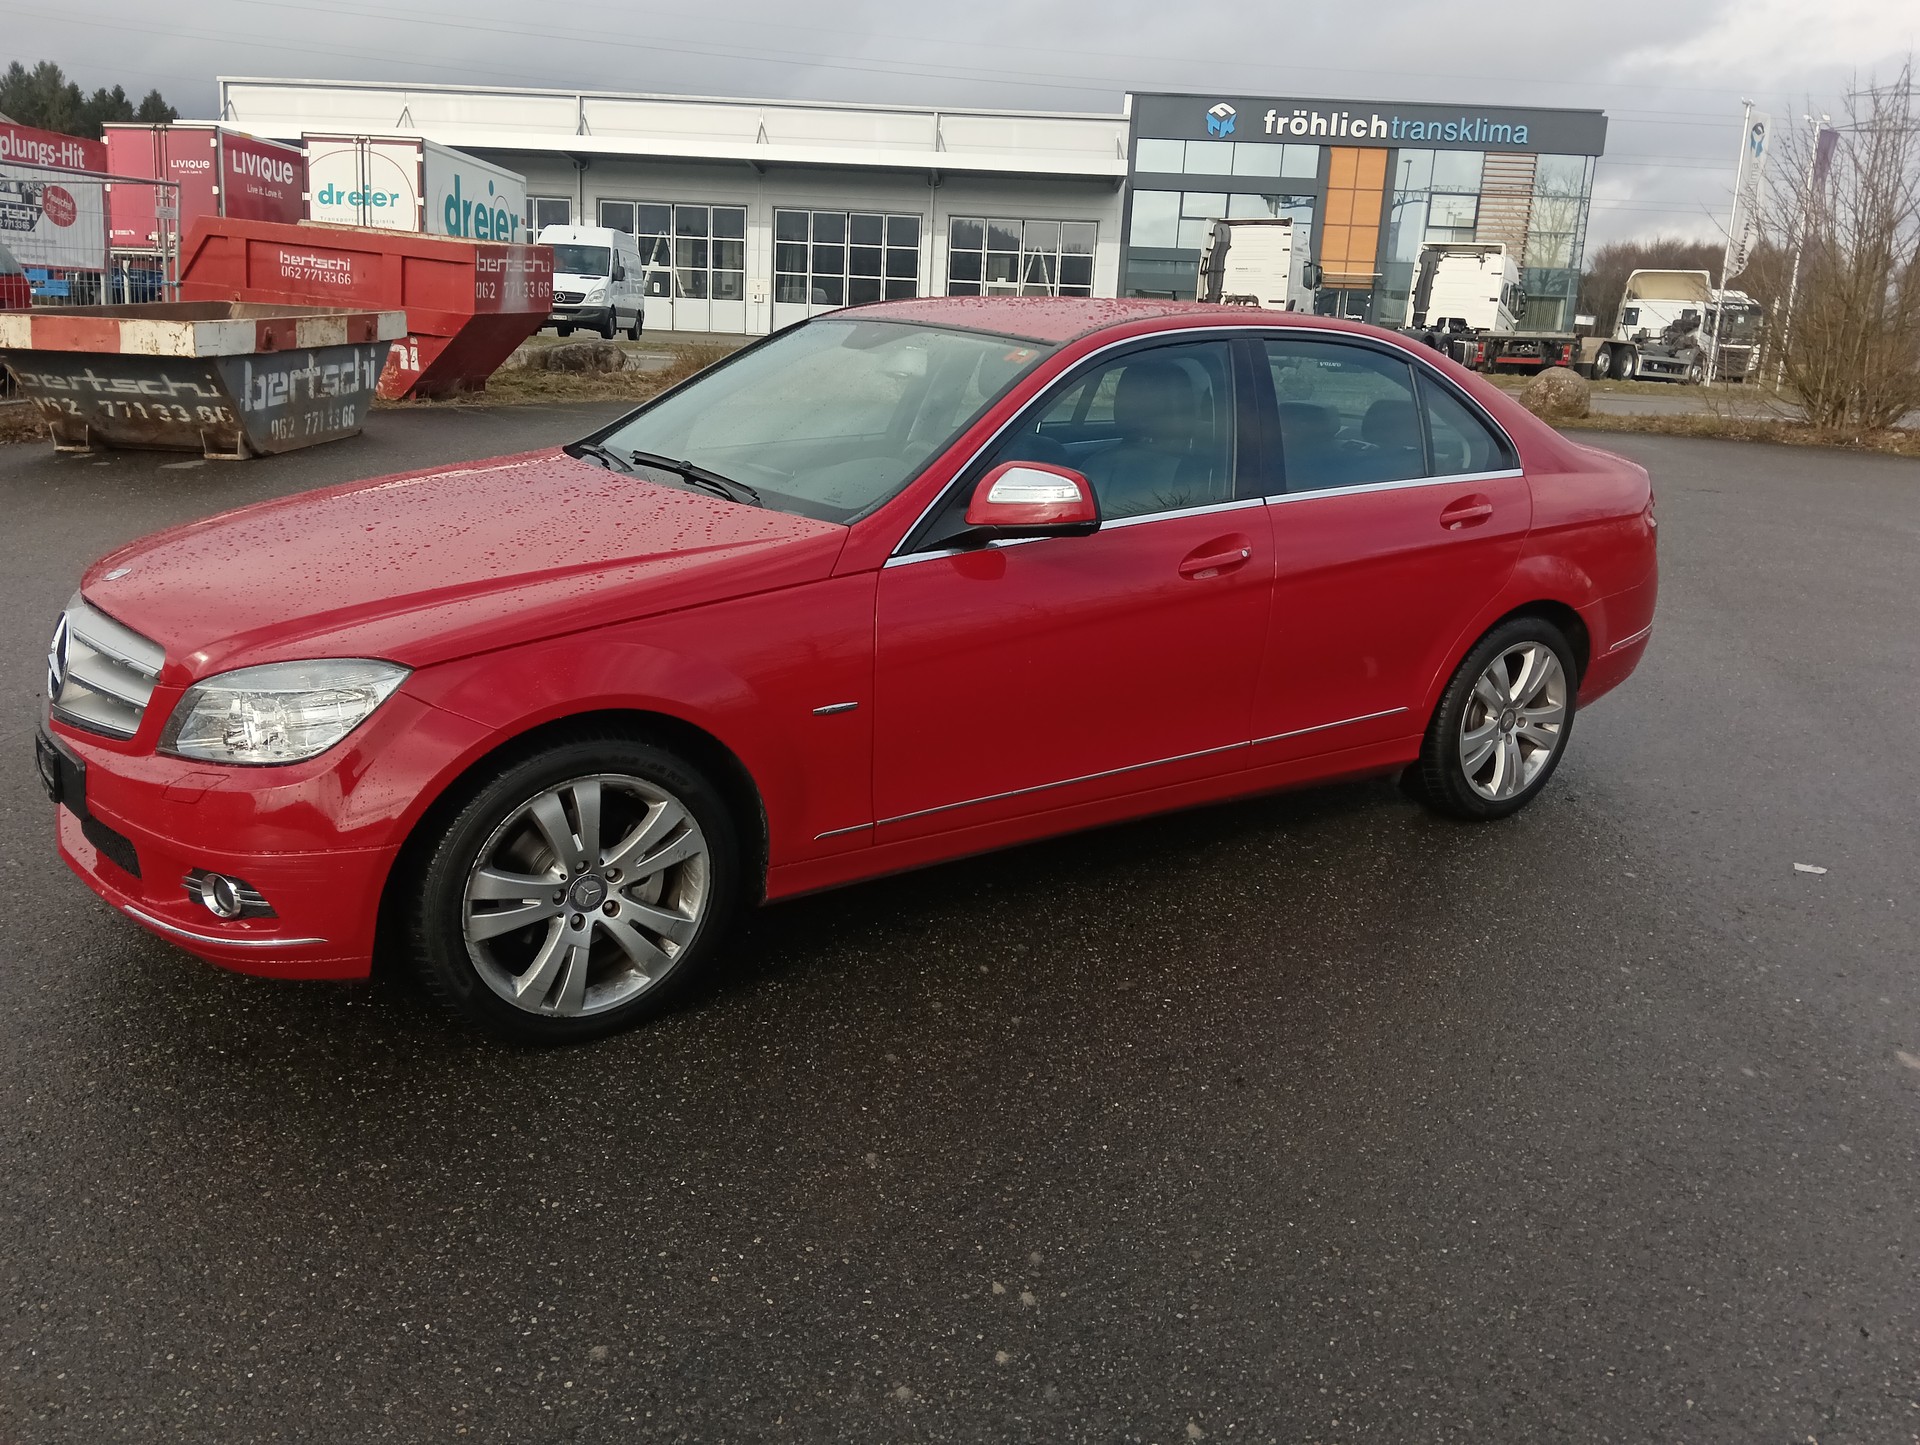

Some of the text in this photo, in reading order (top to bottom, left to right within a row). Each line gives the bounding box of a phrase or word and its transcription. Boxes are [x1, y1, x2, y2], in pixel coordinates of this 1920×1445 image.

[318, 183, 399, 207] dreier
[445, 174, 518, 242] dreier
[280, 250, 350, 271] bertschi
[476, 250, 550, 272] bertschi
[281, 266, 301, 279] 062
[476, 282, 495, 299] 062
[245, 347, 376, 412] bertschi
[271, 417, 295, 440] 062
